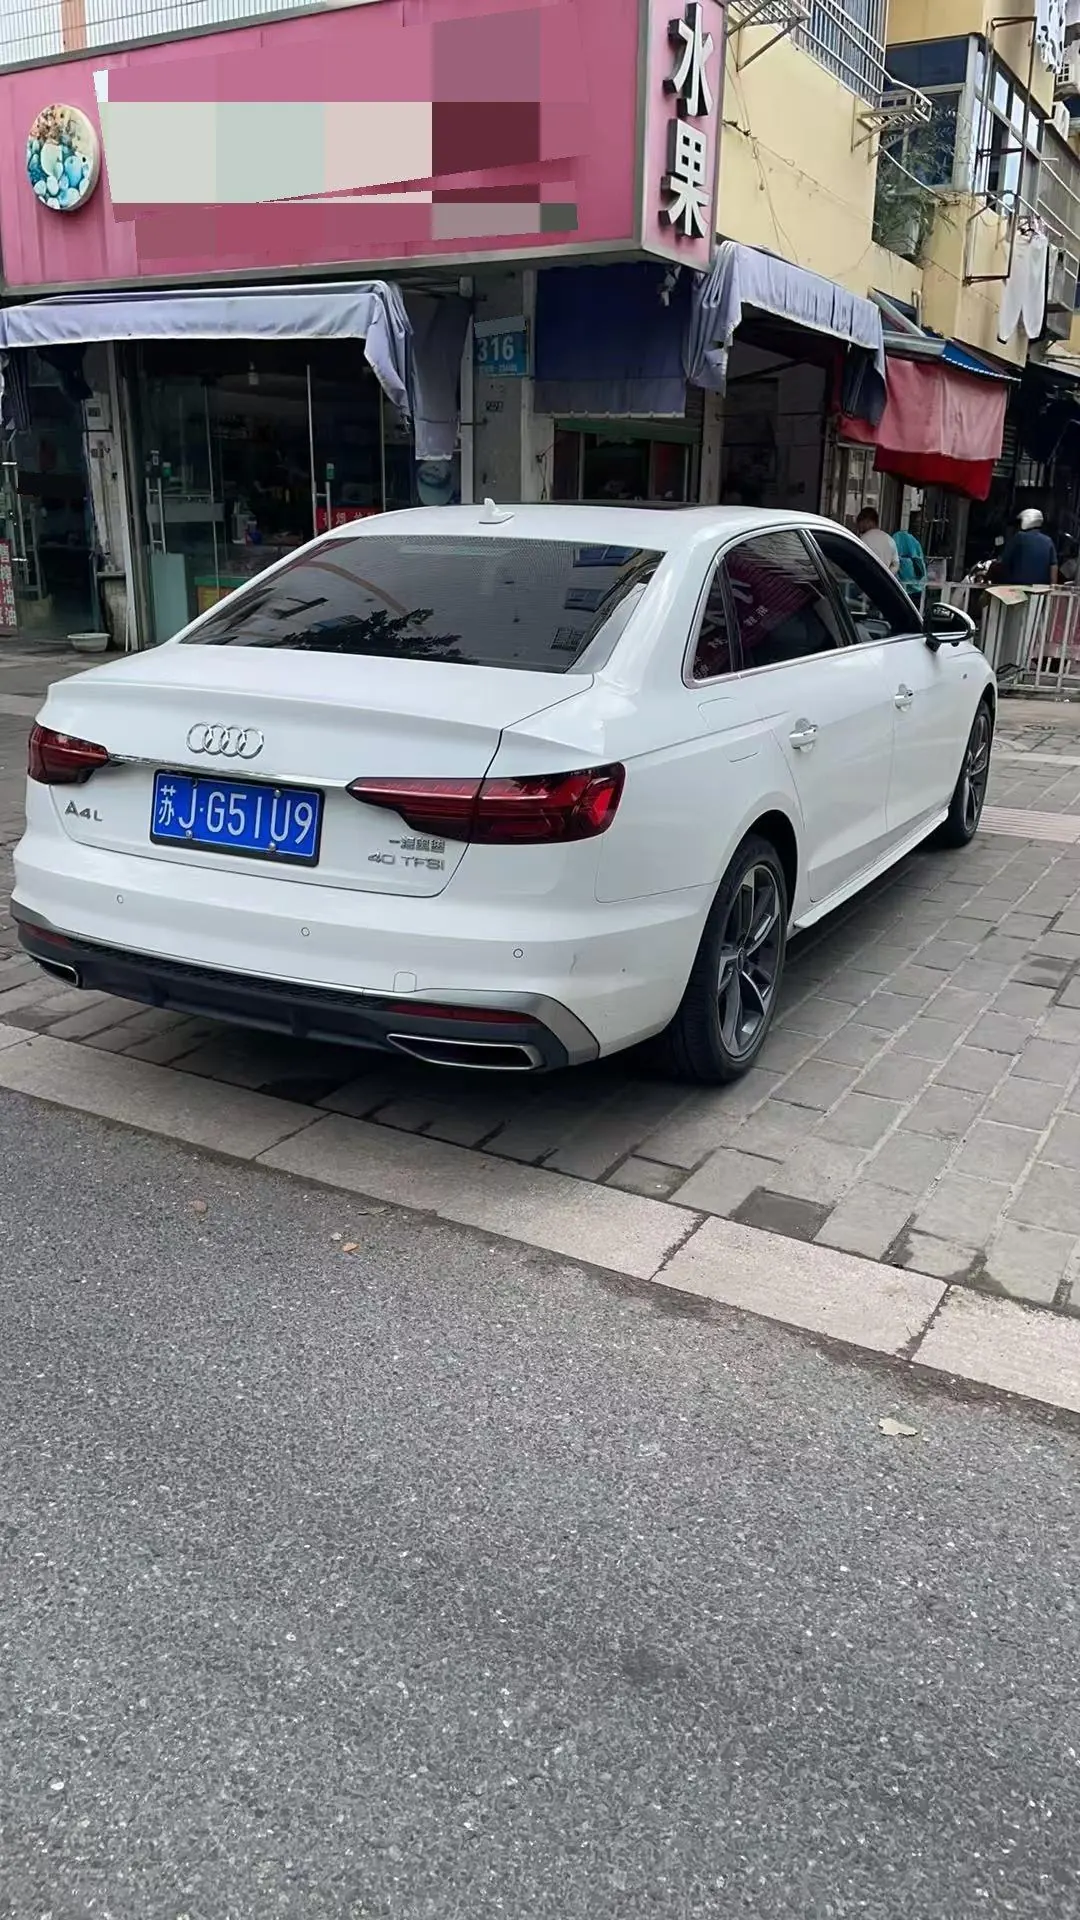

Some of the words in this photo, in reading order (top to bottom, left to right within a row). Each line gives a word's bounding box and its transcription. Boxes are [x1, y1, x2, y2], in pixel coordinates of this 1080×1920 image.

[660, 2, 714, 239] 水果
[477, 336, 515, 362] 316
[367, 851, 396, 865] 40
[400, 856, 445, 871] TFSI
